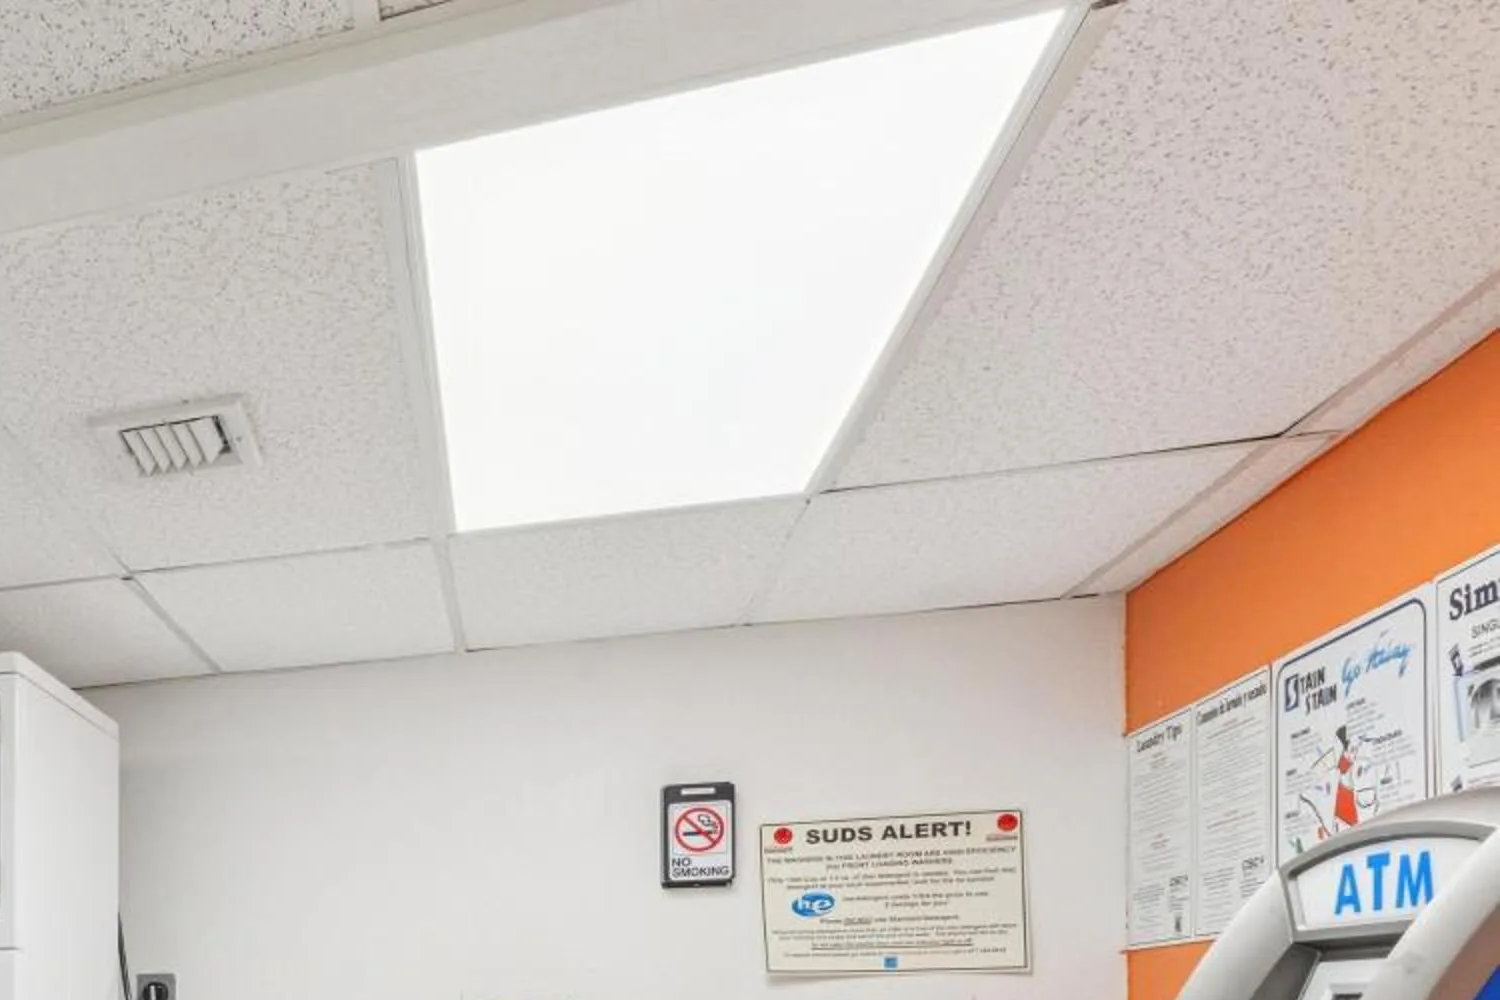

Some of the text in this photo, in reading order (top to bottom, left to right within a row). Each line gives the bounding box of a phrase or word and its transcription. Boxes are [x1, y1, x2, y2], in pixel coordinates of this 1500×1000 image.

[1449, 579, 1500, 621] Sim
[805, 820, 972, 845] SUDS ALERT!
[671, 857, 692, 867] NO
[672, 865, 729, 877] SMOKING
[1334, 850, 1434, 915] ATM
